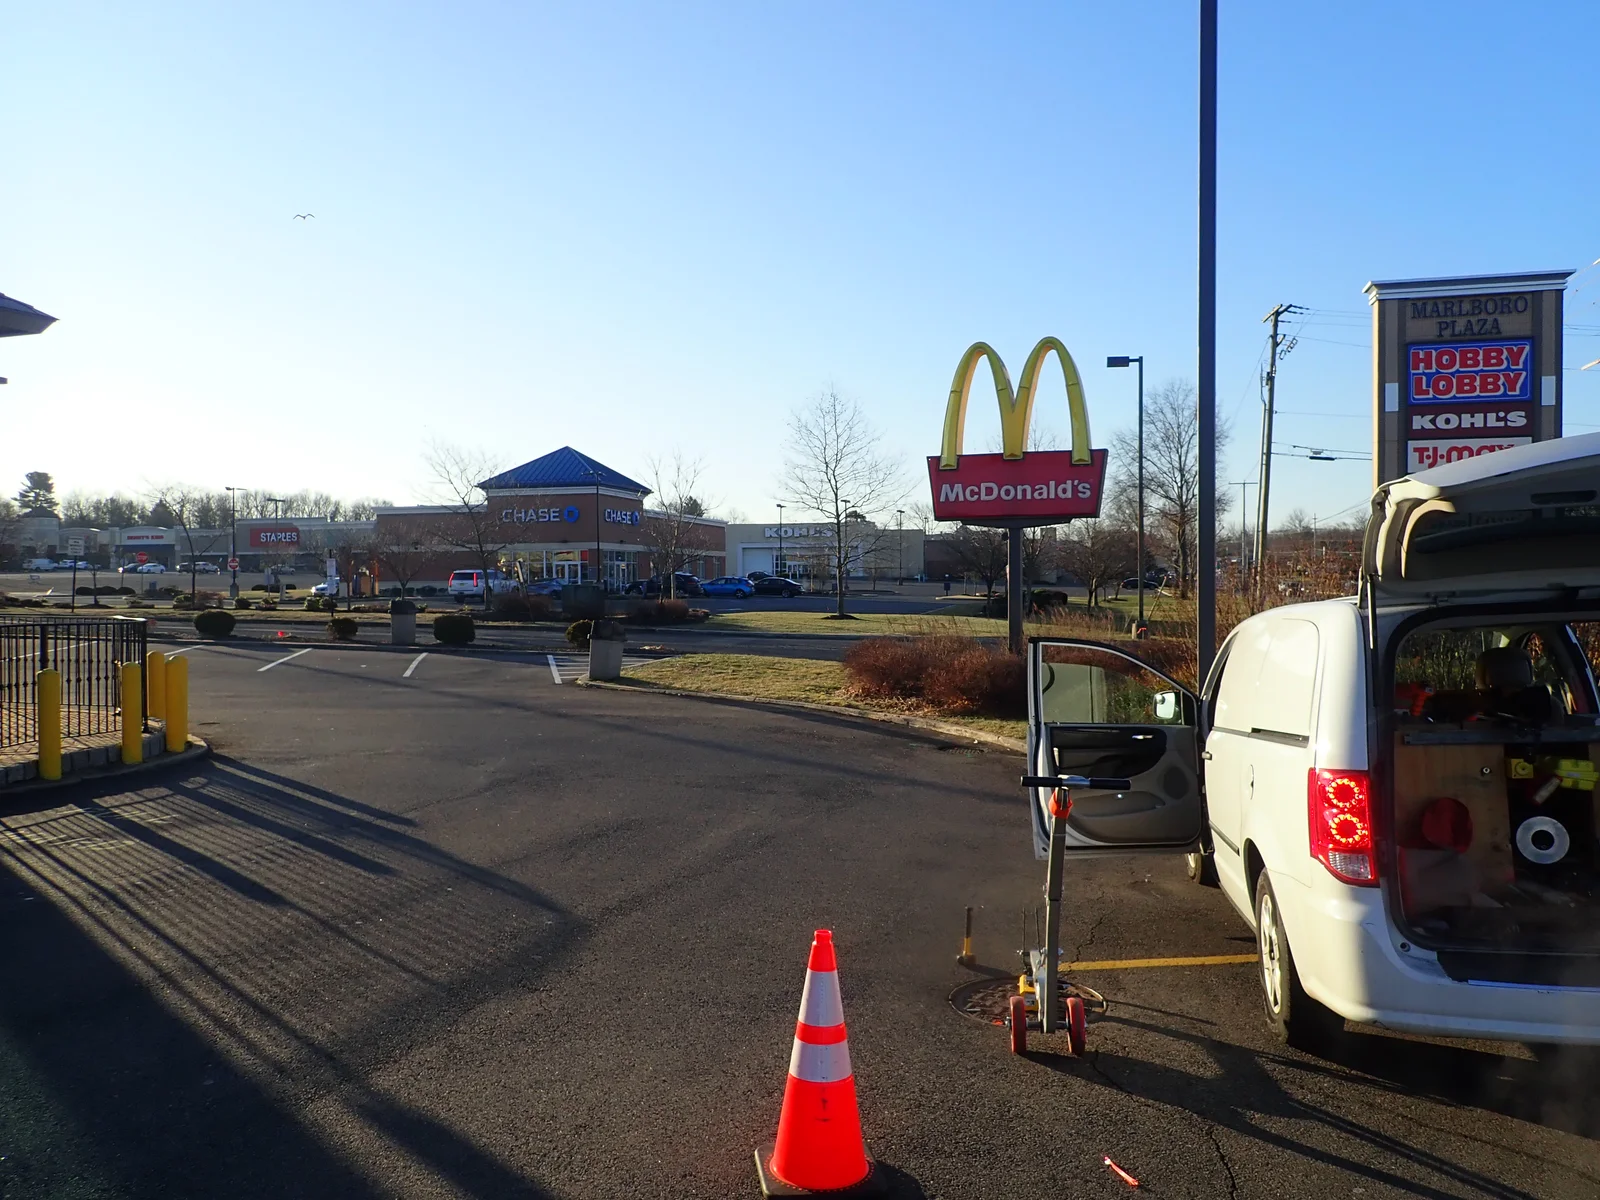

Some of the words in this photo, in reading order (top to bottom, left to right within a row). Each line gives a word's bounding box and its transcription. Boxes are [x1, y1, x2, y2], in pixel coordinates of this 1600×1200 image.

[1411, 296, 1529, 319] MARLBORO
[1437, 318, 1502, 338] PLAZA
[1410, 345, 1529, 372] HOBBY
[1412, 371, 1526, 399] LOBBY
[1412, 411, 1528, 430] KOHL'S
[939, 479, 1092, 503] McDonald's
[502, 508, 561, 523] CHASE
[605, 509, 632, 524] CHASE
[260, 532, 298, 543] STAPLES
